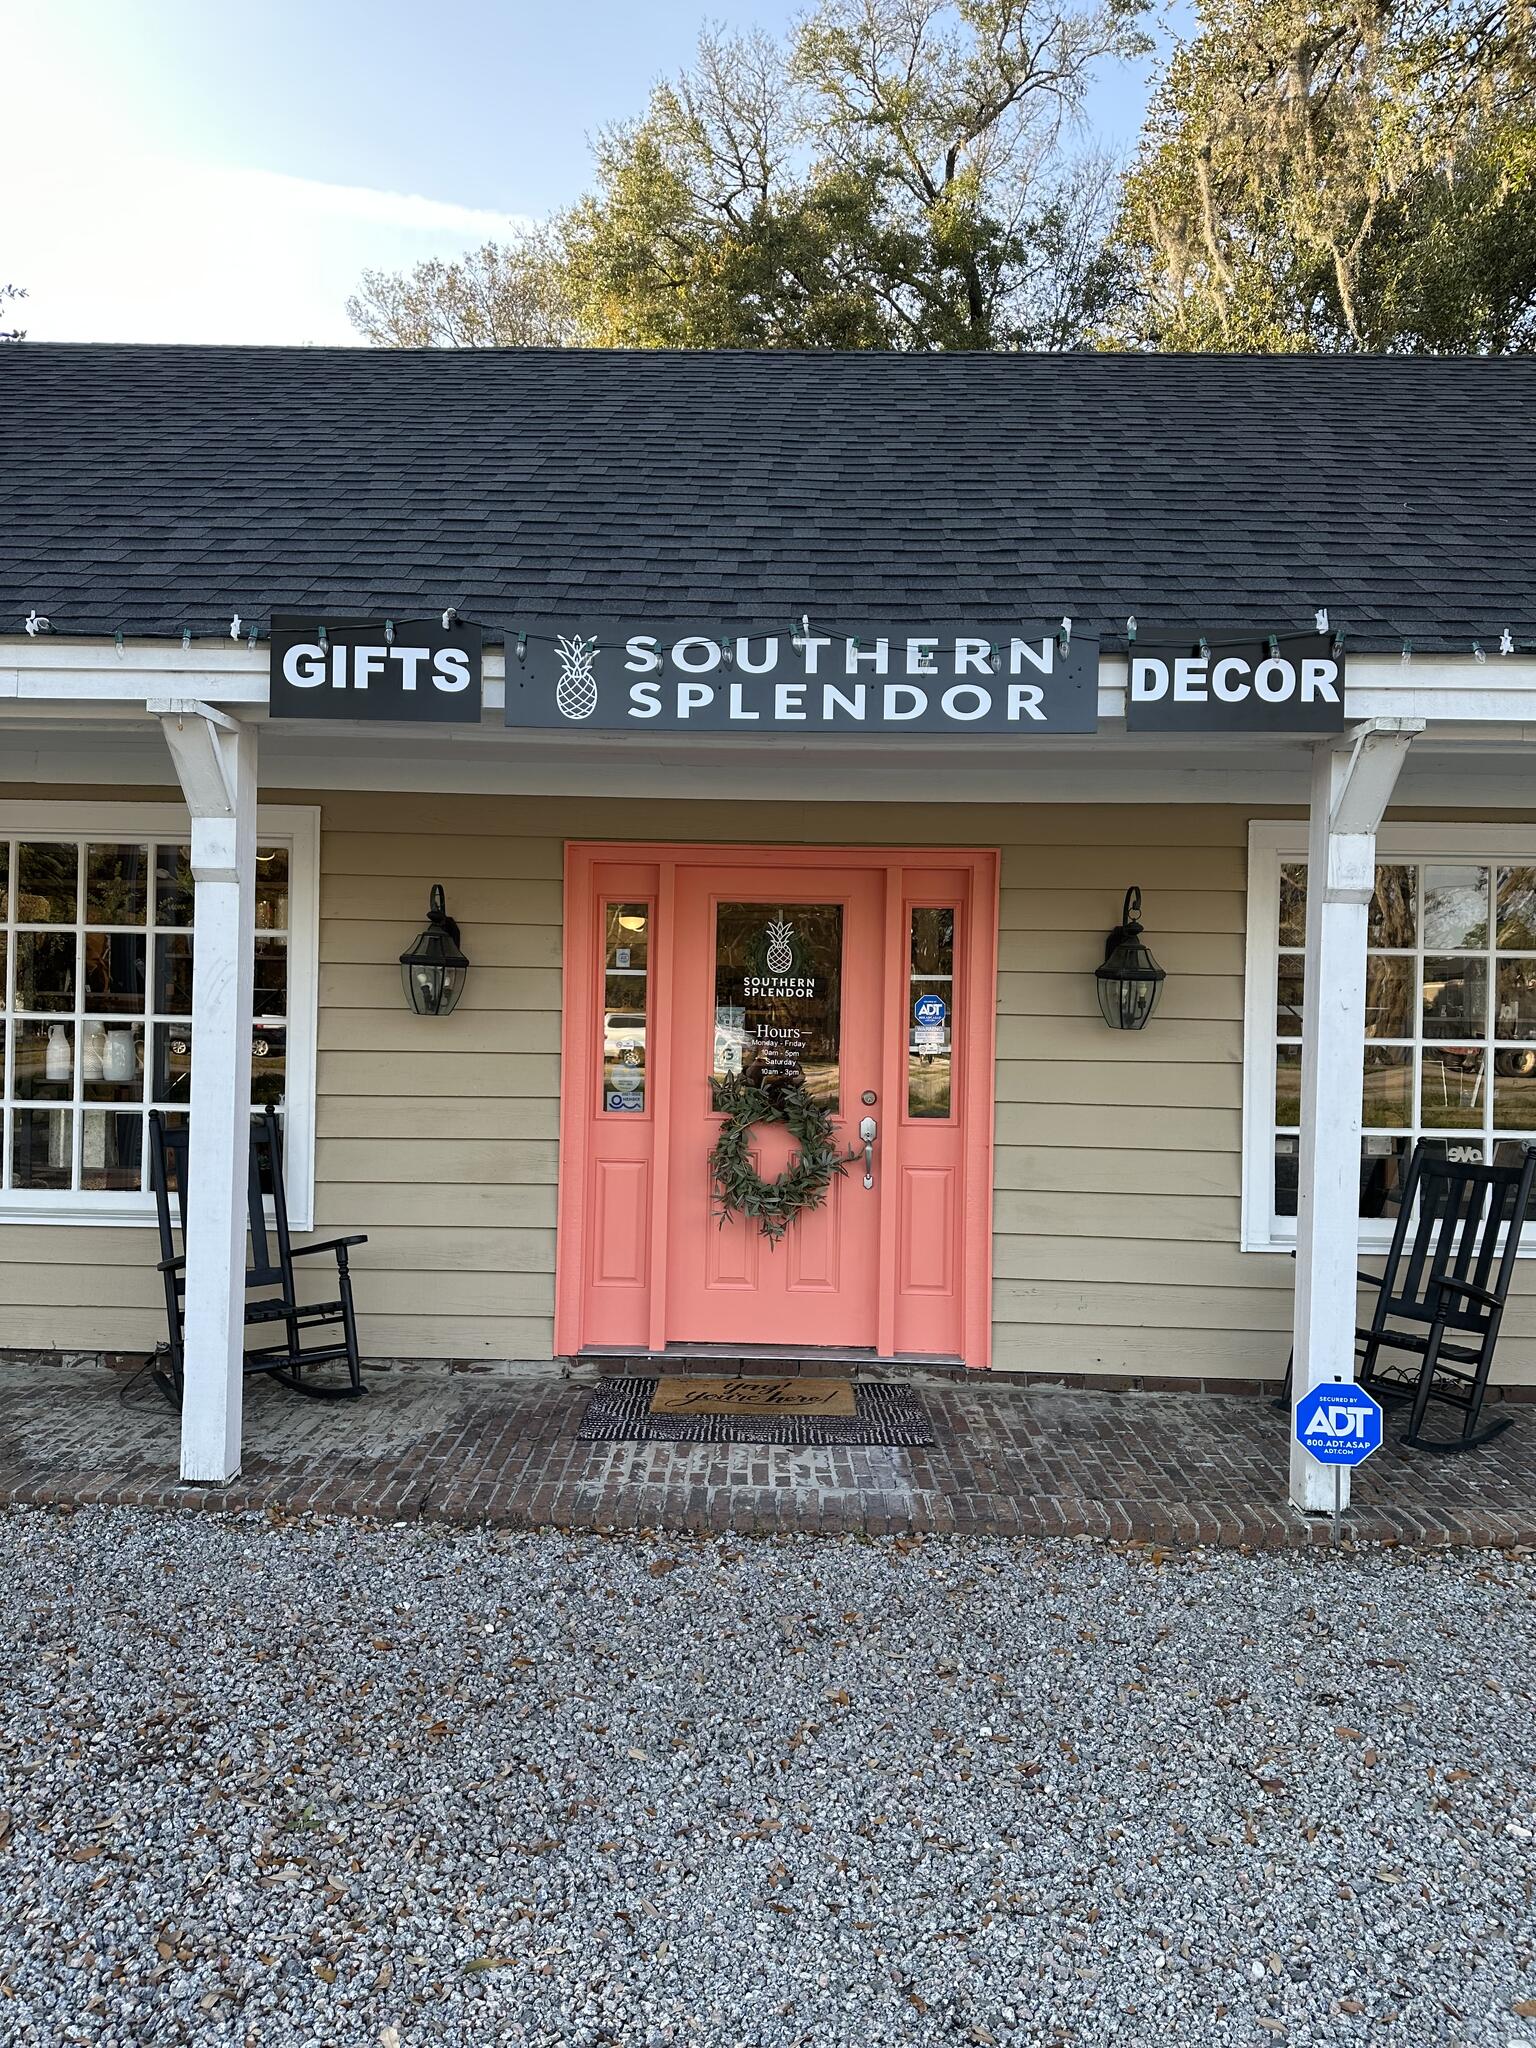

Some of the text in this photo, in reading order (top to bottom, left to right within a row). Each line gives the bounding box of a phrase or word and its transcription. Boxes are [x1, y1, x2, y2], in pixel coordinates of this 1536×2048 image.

[624, 635, 1054, 675] SOUTHERN
[282, 643, 471, 692] GIFTS
[1131, 657, 1340, 703] DECOR
[628, 681, 1048, 721] SPLENDOR
[743, 977, 815, 987] SOUTHERN
[743, 987, 814, 998] SPLENDOR
[918, 1003, 943, 1016] ADT
[757, 1024, 800, 1038] Hours
[751, 1039, 779, 1048] Monday
[784, 1040, 806, 1048] Friday
[765, 1058, 797, 1067] Saturday
[784, 1068, 800, 1076] 3pm
[1304, 1405, 1373, 1438] ADT
[1306, 1439, 1371, 1449] 800.ADT.ASAP
